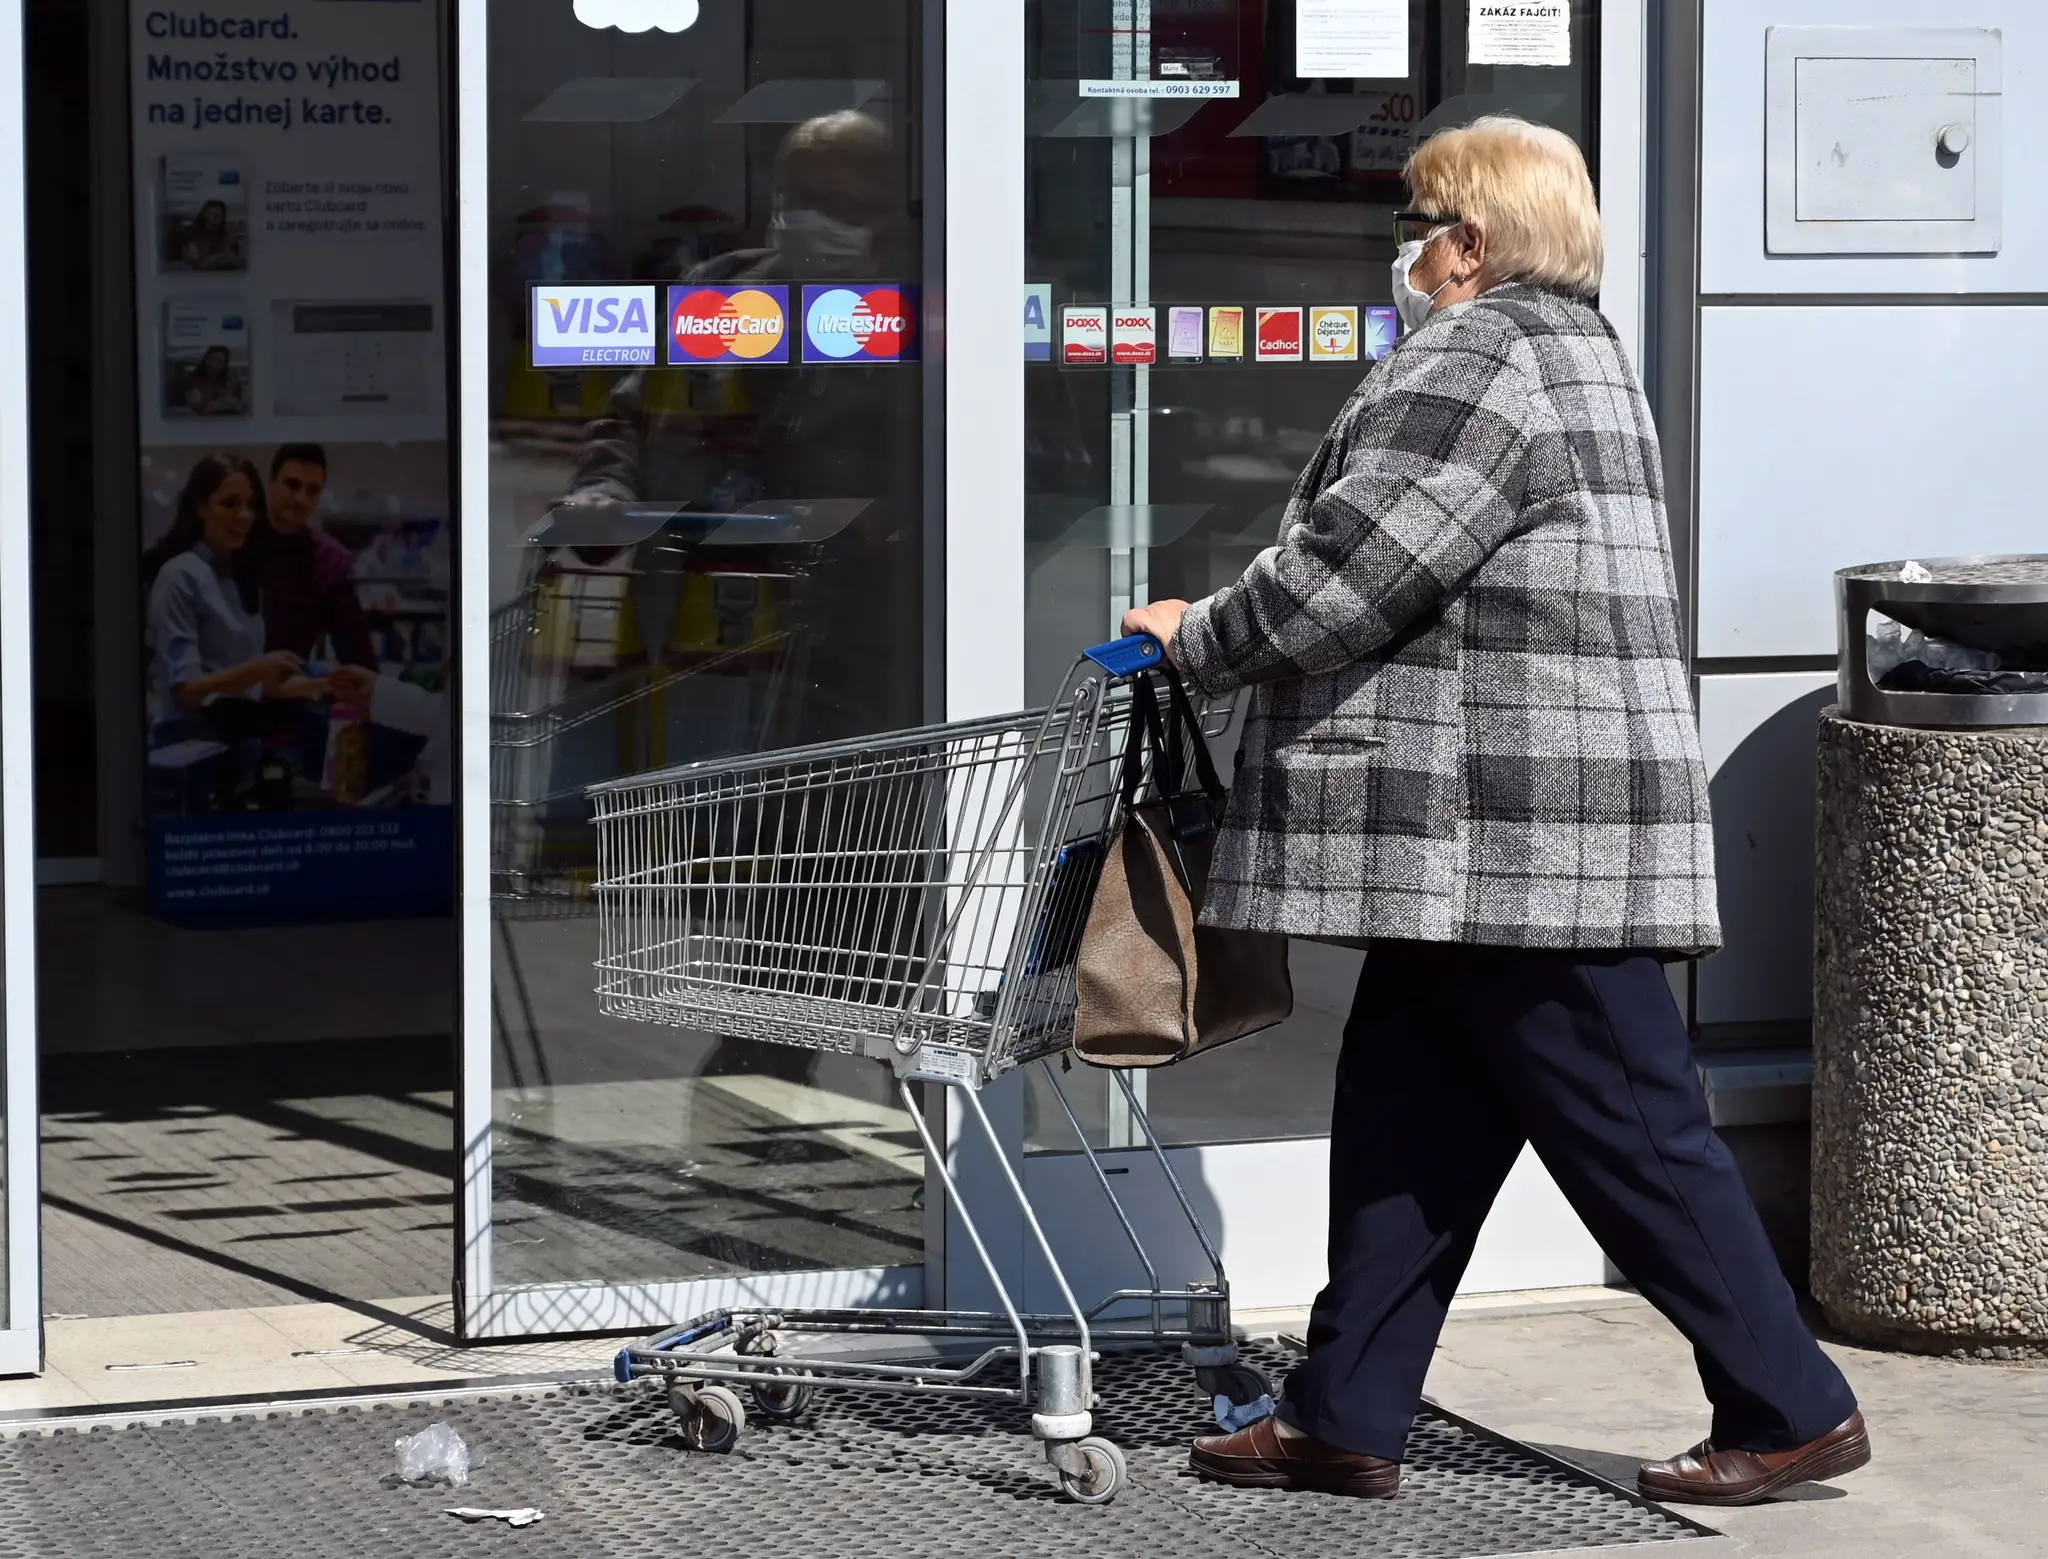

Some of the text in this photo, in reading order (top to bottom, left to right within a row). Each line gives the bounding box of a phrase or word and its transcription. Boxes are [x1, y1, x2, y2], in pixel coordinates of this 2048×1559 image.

[1480, 5, 1561, 17] ZÁKAZ FAJČIŤ!
[146, 12, 299, 39] Clubcard.
[147, 52, 400, 87] Množstvo výhod
[1087, 86, 1125, 94] Kontaktná
[1166, 85, 1190, 95] 0903
[1192, 85, 1210, 95] 629
[1212, 85, 1231, 95] 597
[148, 98, 392, 130] na jednej karte.
[265, 199, 368, 213] kartu Clubcard
[542, 297, 650, 334] VISA
[675, 314, 780, 336] MasterCard
[816, 312, 907, 334] Maestro
[1066, 318, 1104, 332] DOXX
[1115, 317, 1154, 332] DOXX
[1319, 320, 1348, 330] Chèque
[1317, 327, 1351, 337] Déjeuner
[1259, 339, 1298, 350] Cadhoc
[582, 349, 651, 362] ELECTRON
